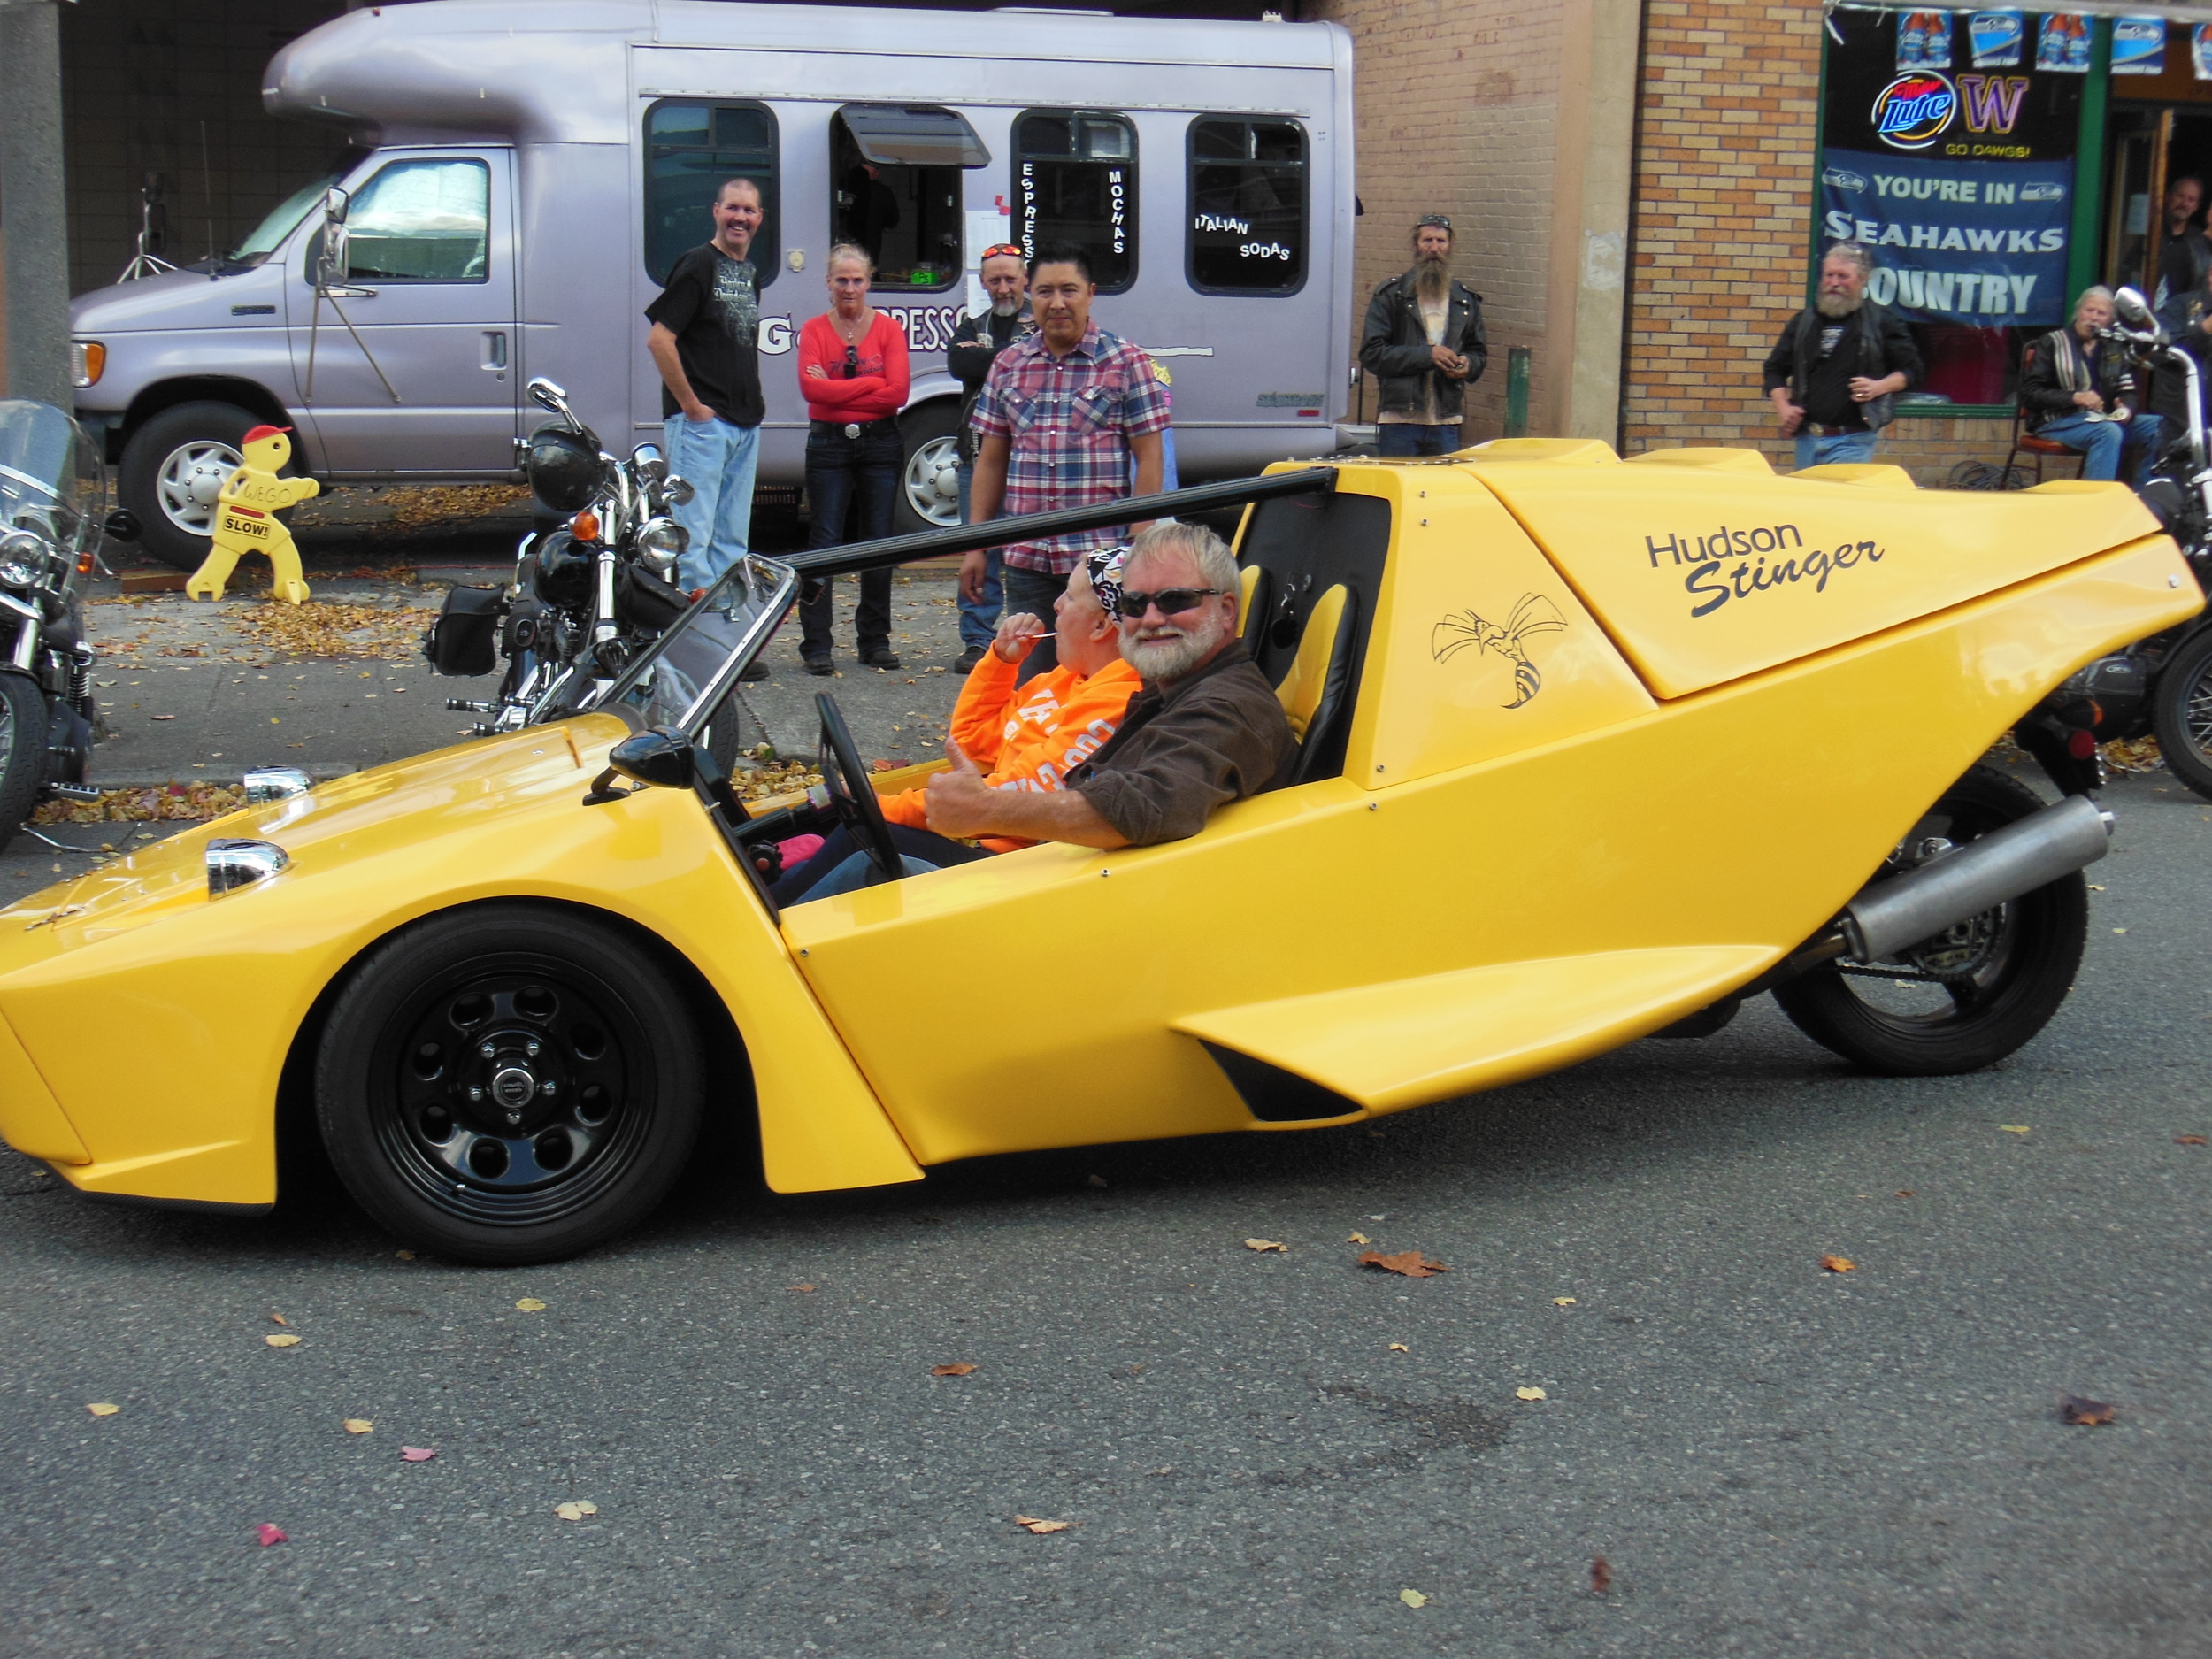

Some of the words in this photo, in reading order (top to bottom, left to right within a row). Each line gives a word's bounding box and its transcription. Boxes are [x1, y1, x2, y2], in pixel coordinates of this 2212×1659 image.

[1878, 92, 1953, 134] Lite
[1956, 73, 2031, 134] W
[1946, 142, 1969, 157] GO
[1973, 144, 2032, 159] DAWGS!
[1872, 174, 1978, 204] YOU'RE
[1985, 182, 2016, 204] IN
[1108, 170, 1125, 254] MOCHAS
[1194, 213, 1249, 236] ITALIAN
[1824, 210, 2067, 253] SEAHAWKS
[1240, 242, 1291, 262] SODAS
[1861, 267, 2038, 314] OUNTRY
[243, 484, 292, 503] WEGO
[225, 518, 270, 537] SLOW!
[1645, 523, 1803, 568] Hudson
[1684, 540, 1886, 618] Stinger
